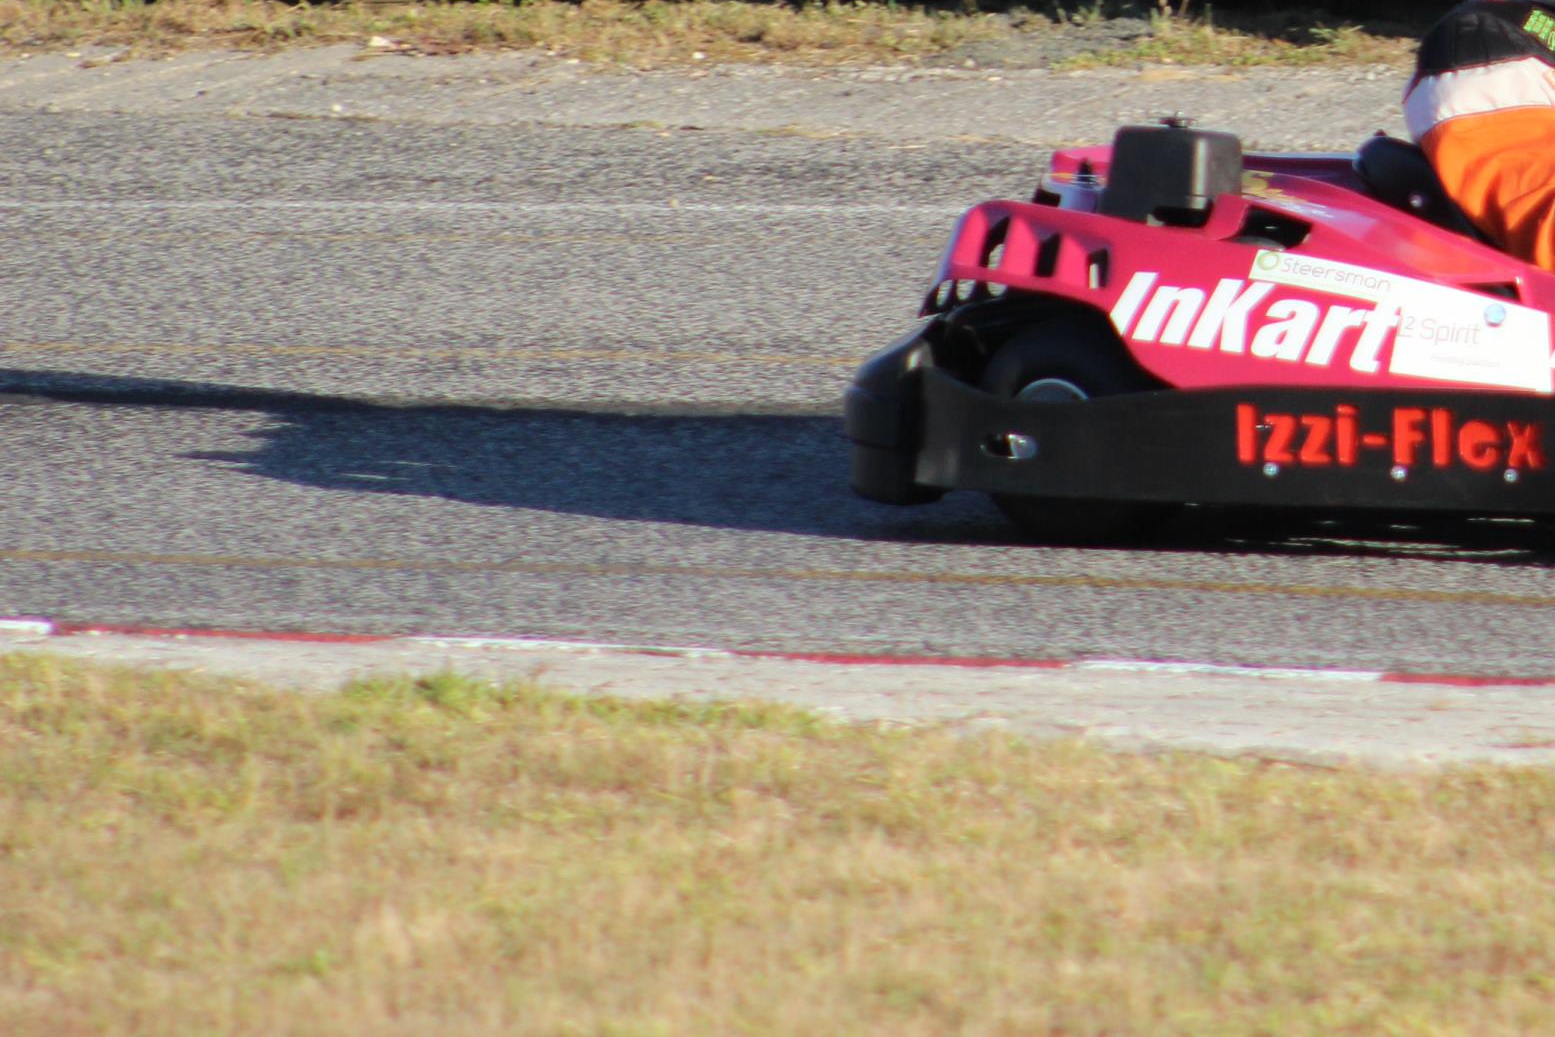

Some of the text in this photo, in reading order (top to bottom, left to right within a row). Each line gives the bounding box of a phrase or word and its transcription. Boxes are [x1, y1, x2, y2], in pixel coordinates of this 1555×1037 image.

[1280, 256, 1392, 293] Steersman
[1111, 271, 1397, 374] InKart
[1419, 317, 1481, 346] Spirit
[1236, 403, 1545, 469] Izzi-Flex
